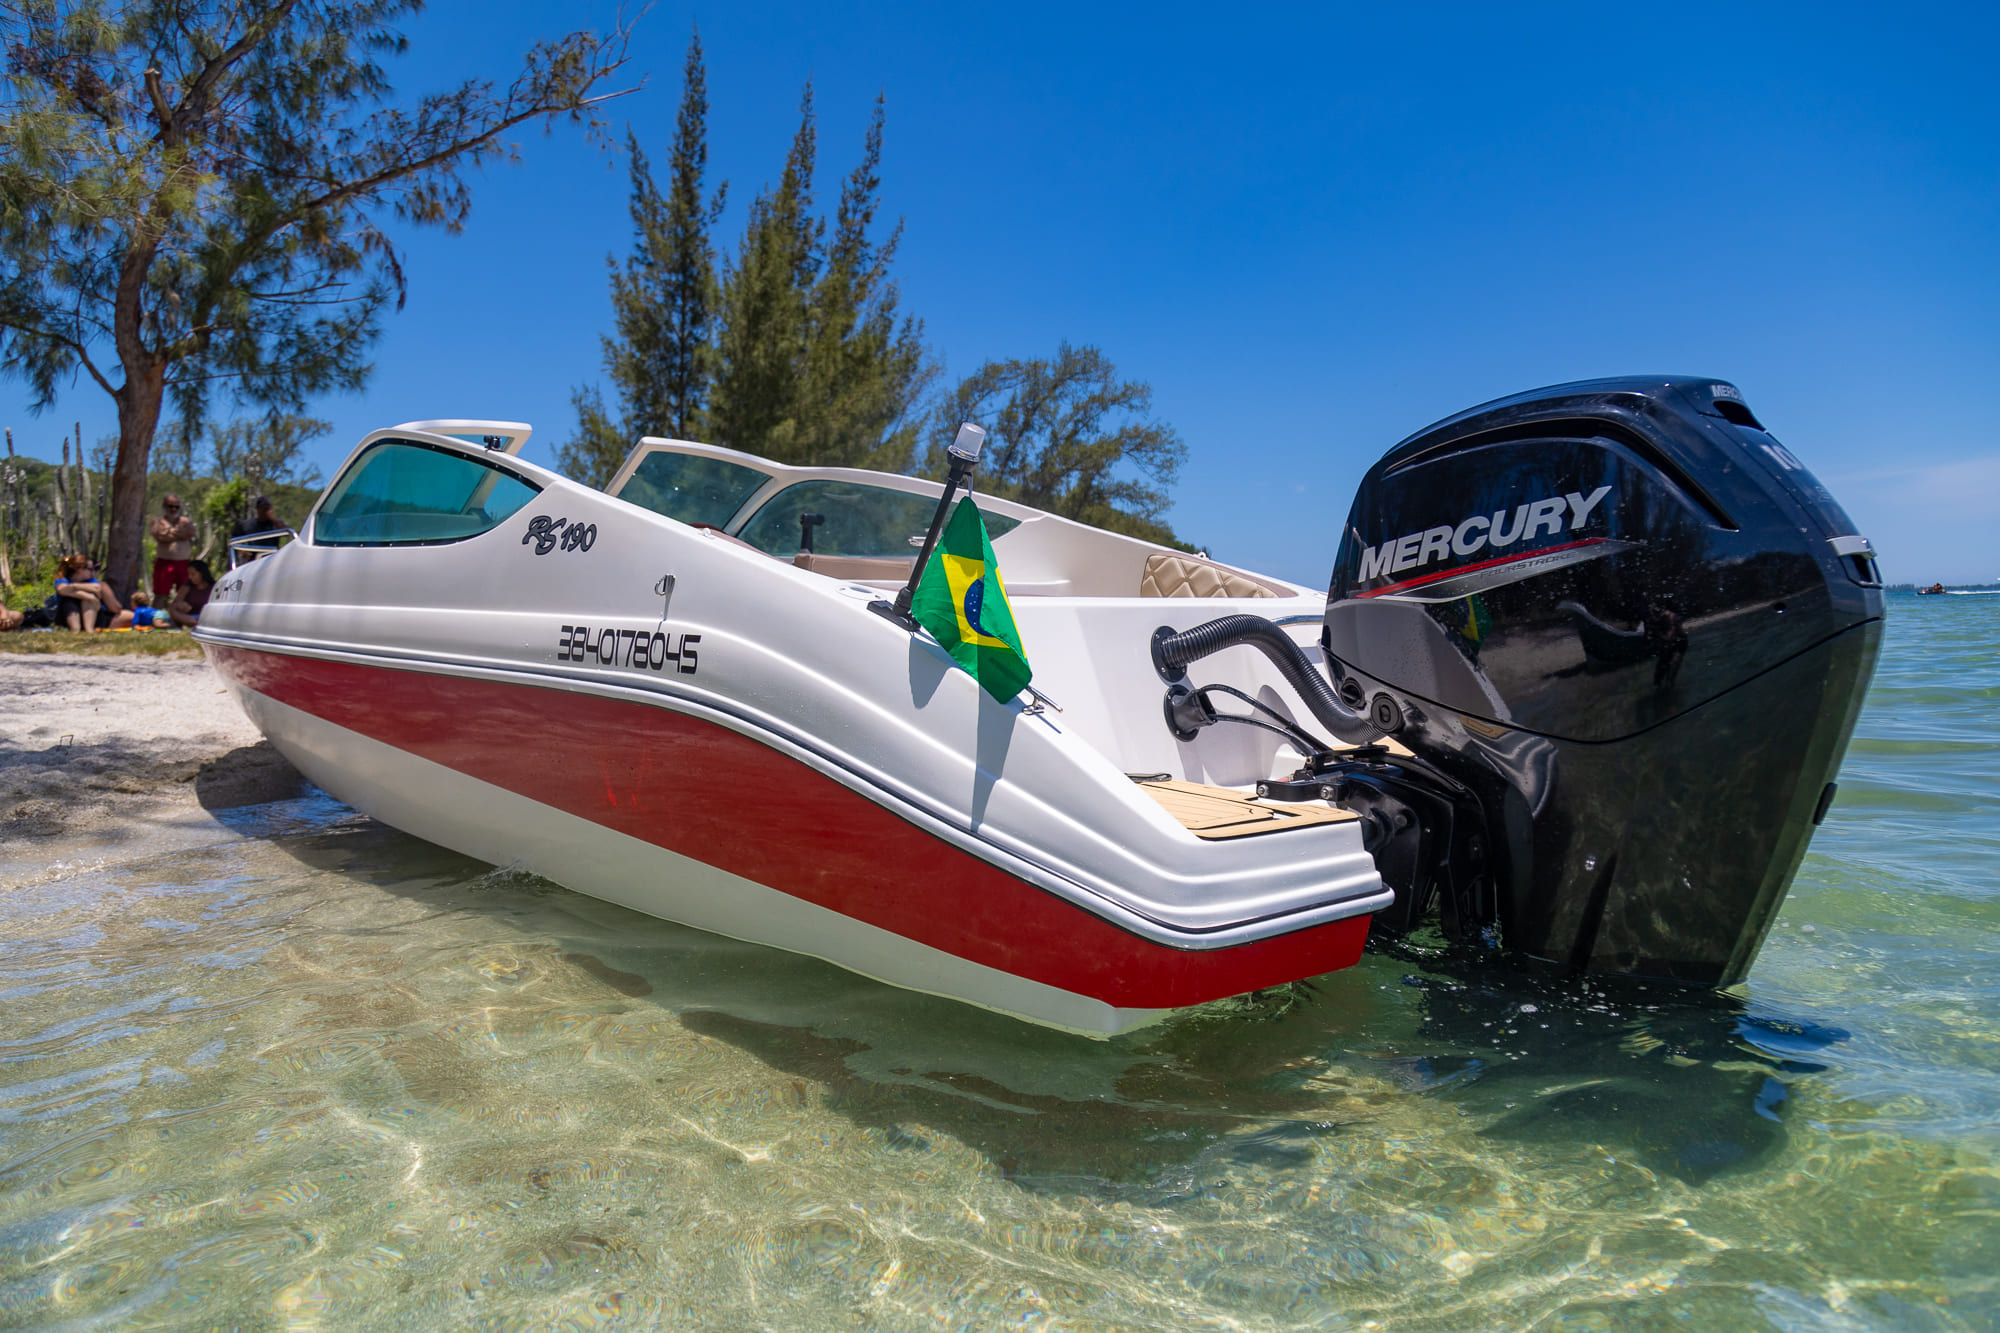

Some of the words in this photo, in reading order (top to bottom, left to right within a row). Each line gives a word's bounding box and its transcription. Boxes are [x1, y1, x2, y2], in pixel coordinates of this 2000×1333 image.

[522, 515, 567, 555] RS
[560, 522, 597, 552] 190
[1358, 485, 1612, 583] MERCURY
[1479, 551, 1578, 579] FOURSTROKE
[557, 625, 702, 675] 3840178045
